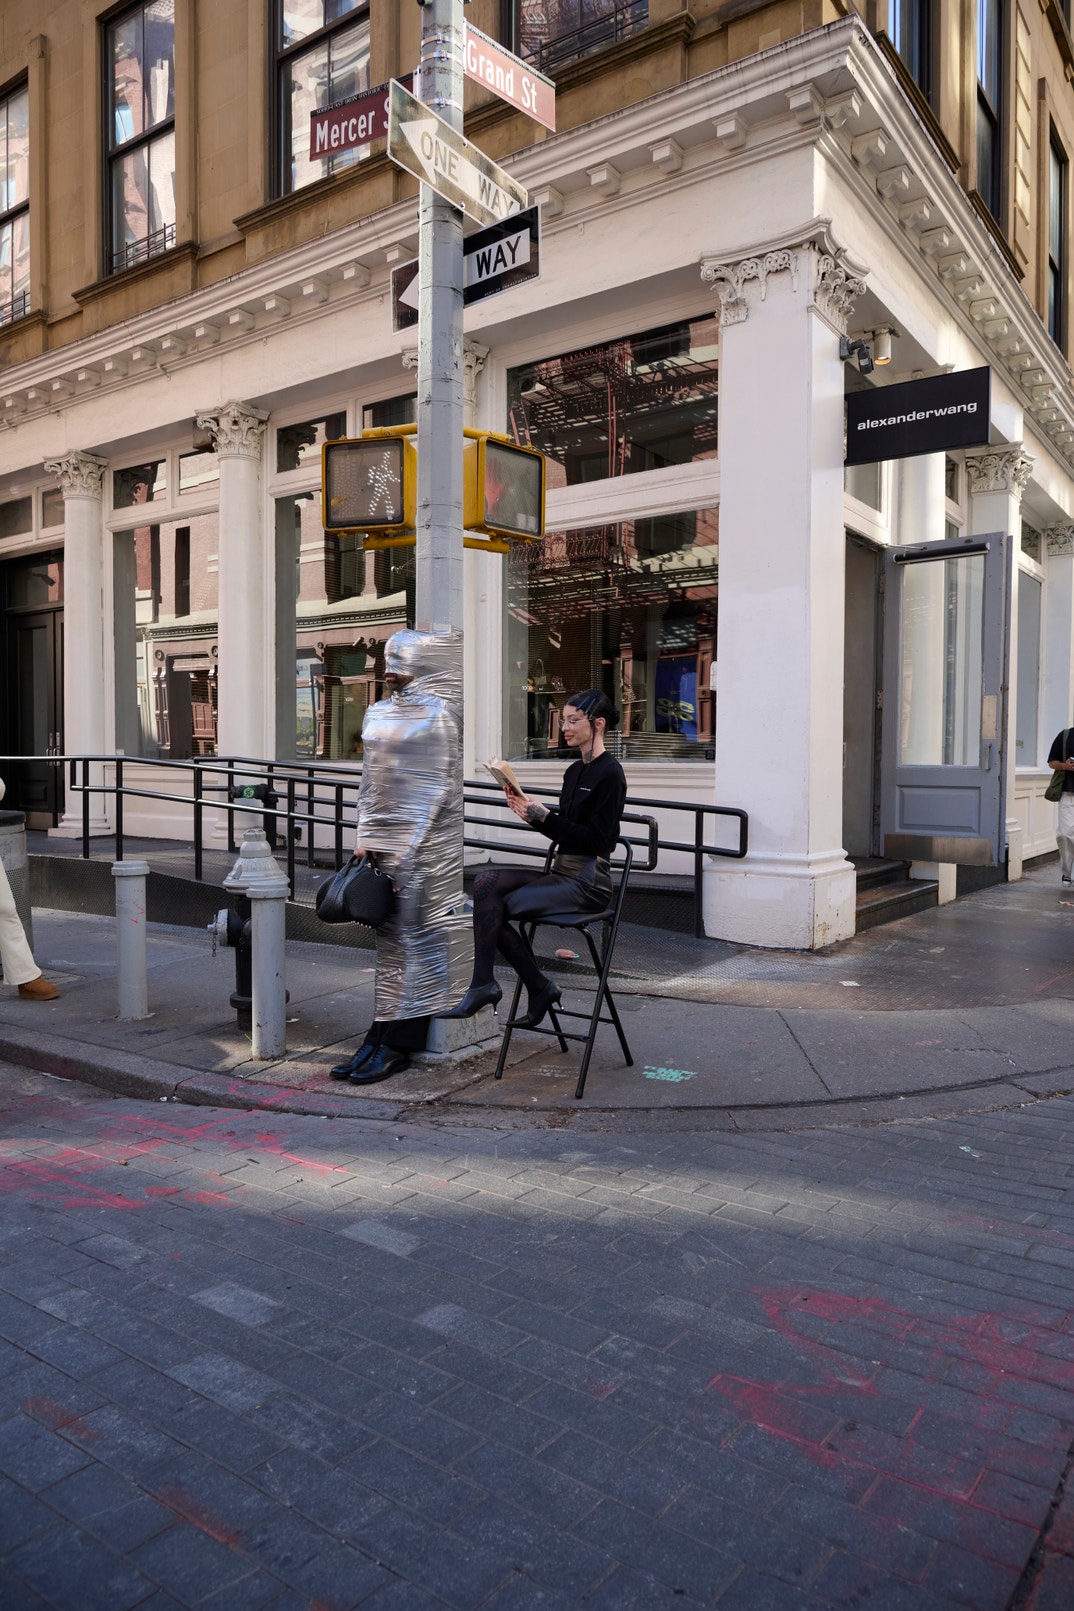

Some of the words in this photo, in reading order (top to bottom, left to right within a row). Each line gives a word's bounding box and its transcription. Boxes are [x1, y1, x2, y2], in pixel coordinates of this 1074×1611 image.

[467, 39, 514, 98] Grand
[521, 76, 537, 113] St
[316, 110, 375, 153] Mercer
[383, 96, 390, 129] S
[421, 131, 459, 182] ONE
[479, 174, 514, 217] WAY
[476, 235, 521, 278] WAY
[857, 402, 977, 430] alexanderwang
